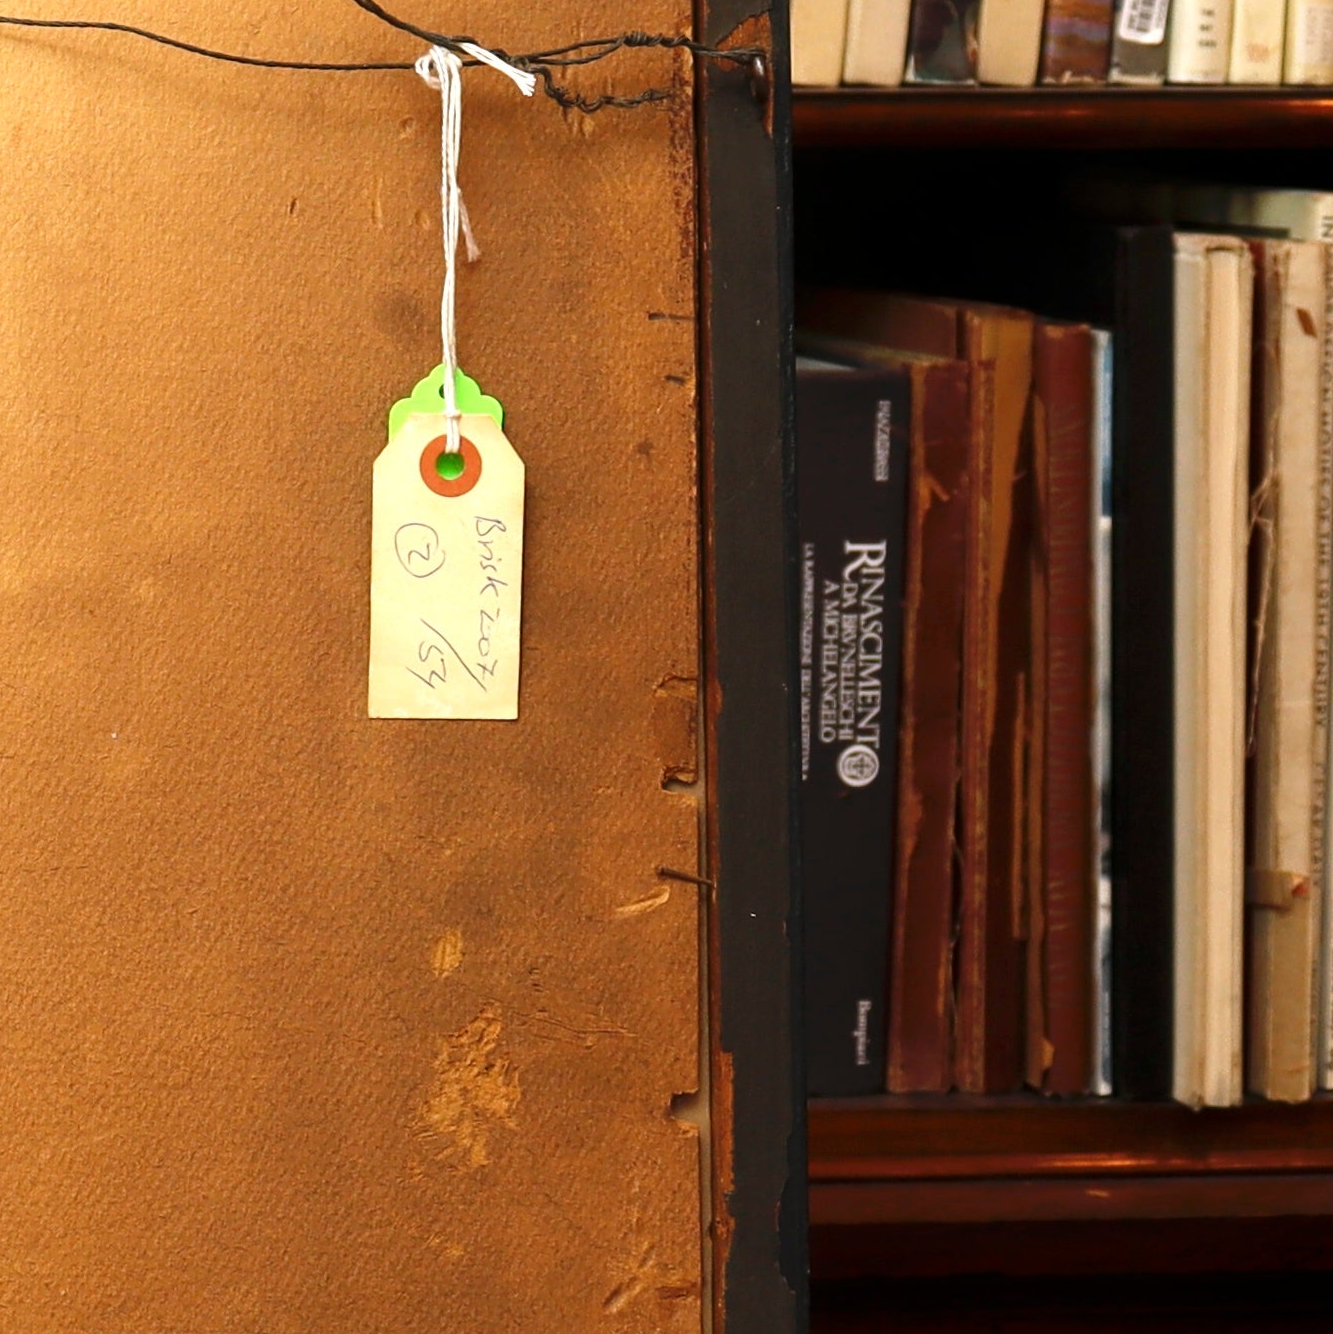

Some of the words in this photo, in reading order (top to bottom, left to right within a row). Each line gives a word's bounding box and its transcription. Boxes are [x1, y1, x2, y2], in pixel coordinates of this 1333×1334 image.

[823, 580, 841, 594] A
[841, 582, 859, 609] DA
[821, 598, 841, 744] MICHELANGELO
